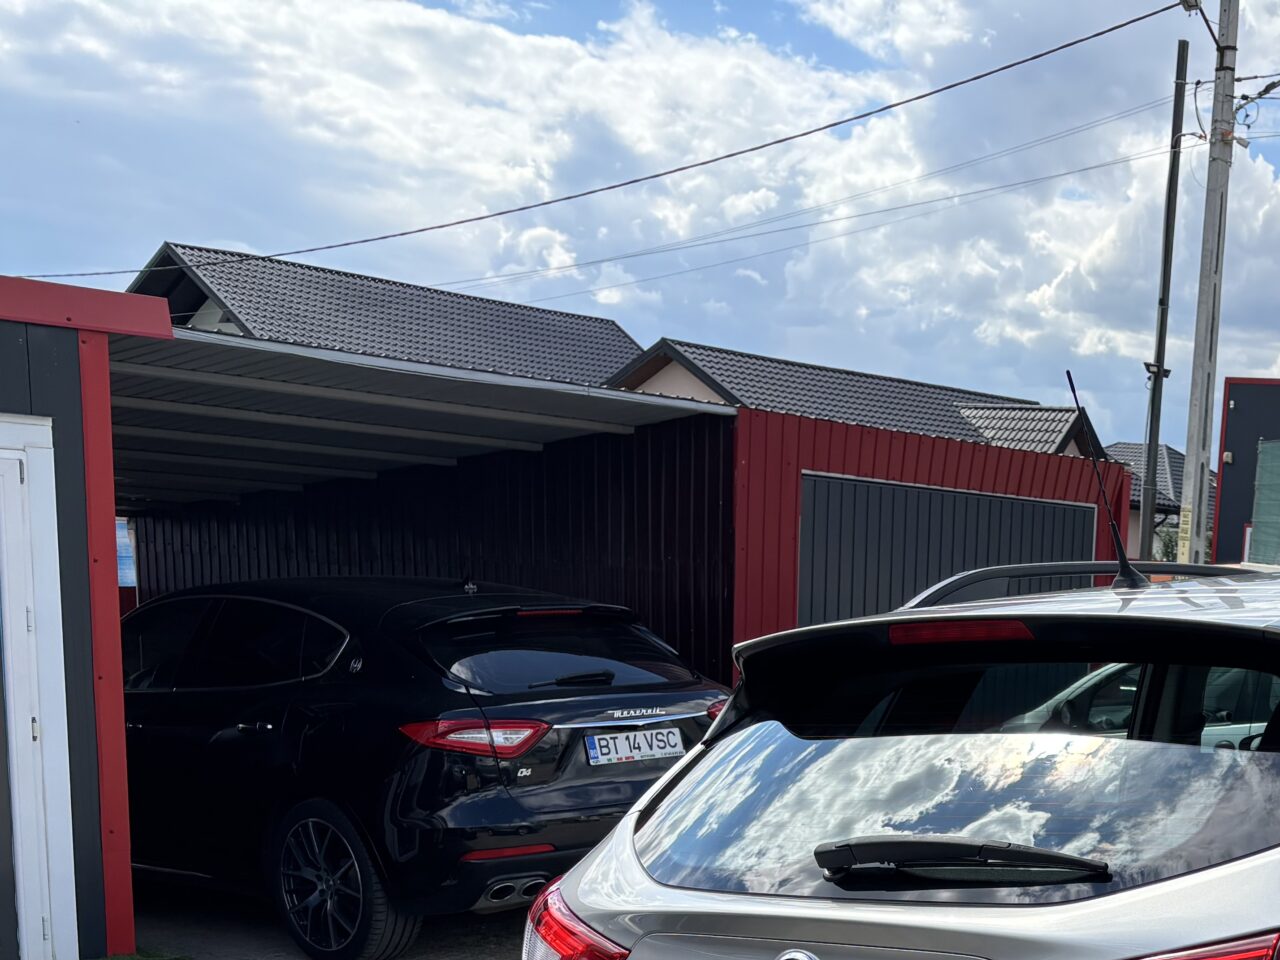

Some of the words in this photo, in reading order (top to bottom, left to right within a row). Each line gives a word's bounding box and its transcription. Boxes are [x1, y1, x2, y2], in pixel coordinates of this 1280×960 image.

[597, 736, 619, 757] BT
[625, 733, 642, 753] 14
[643, 730, 678, 751] VSC
